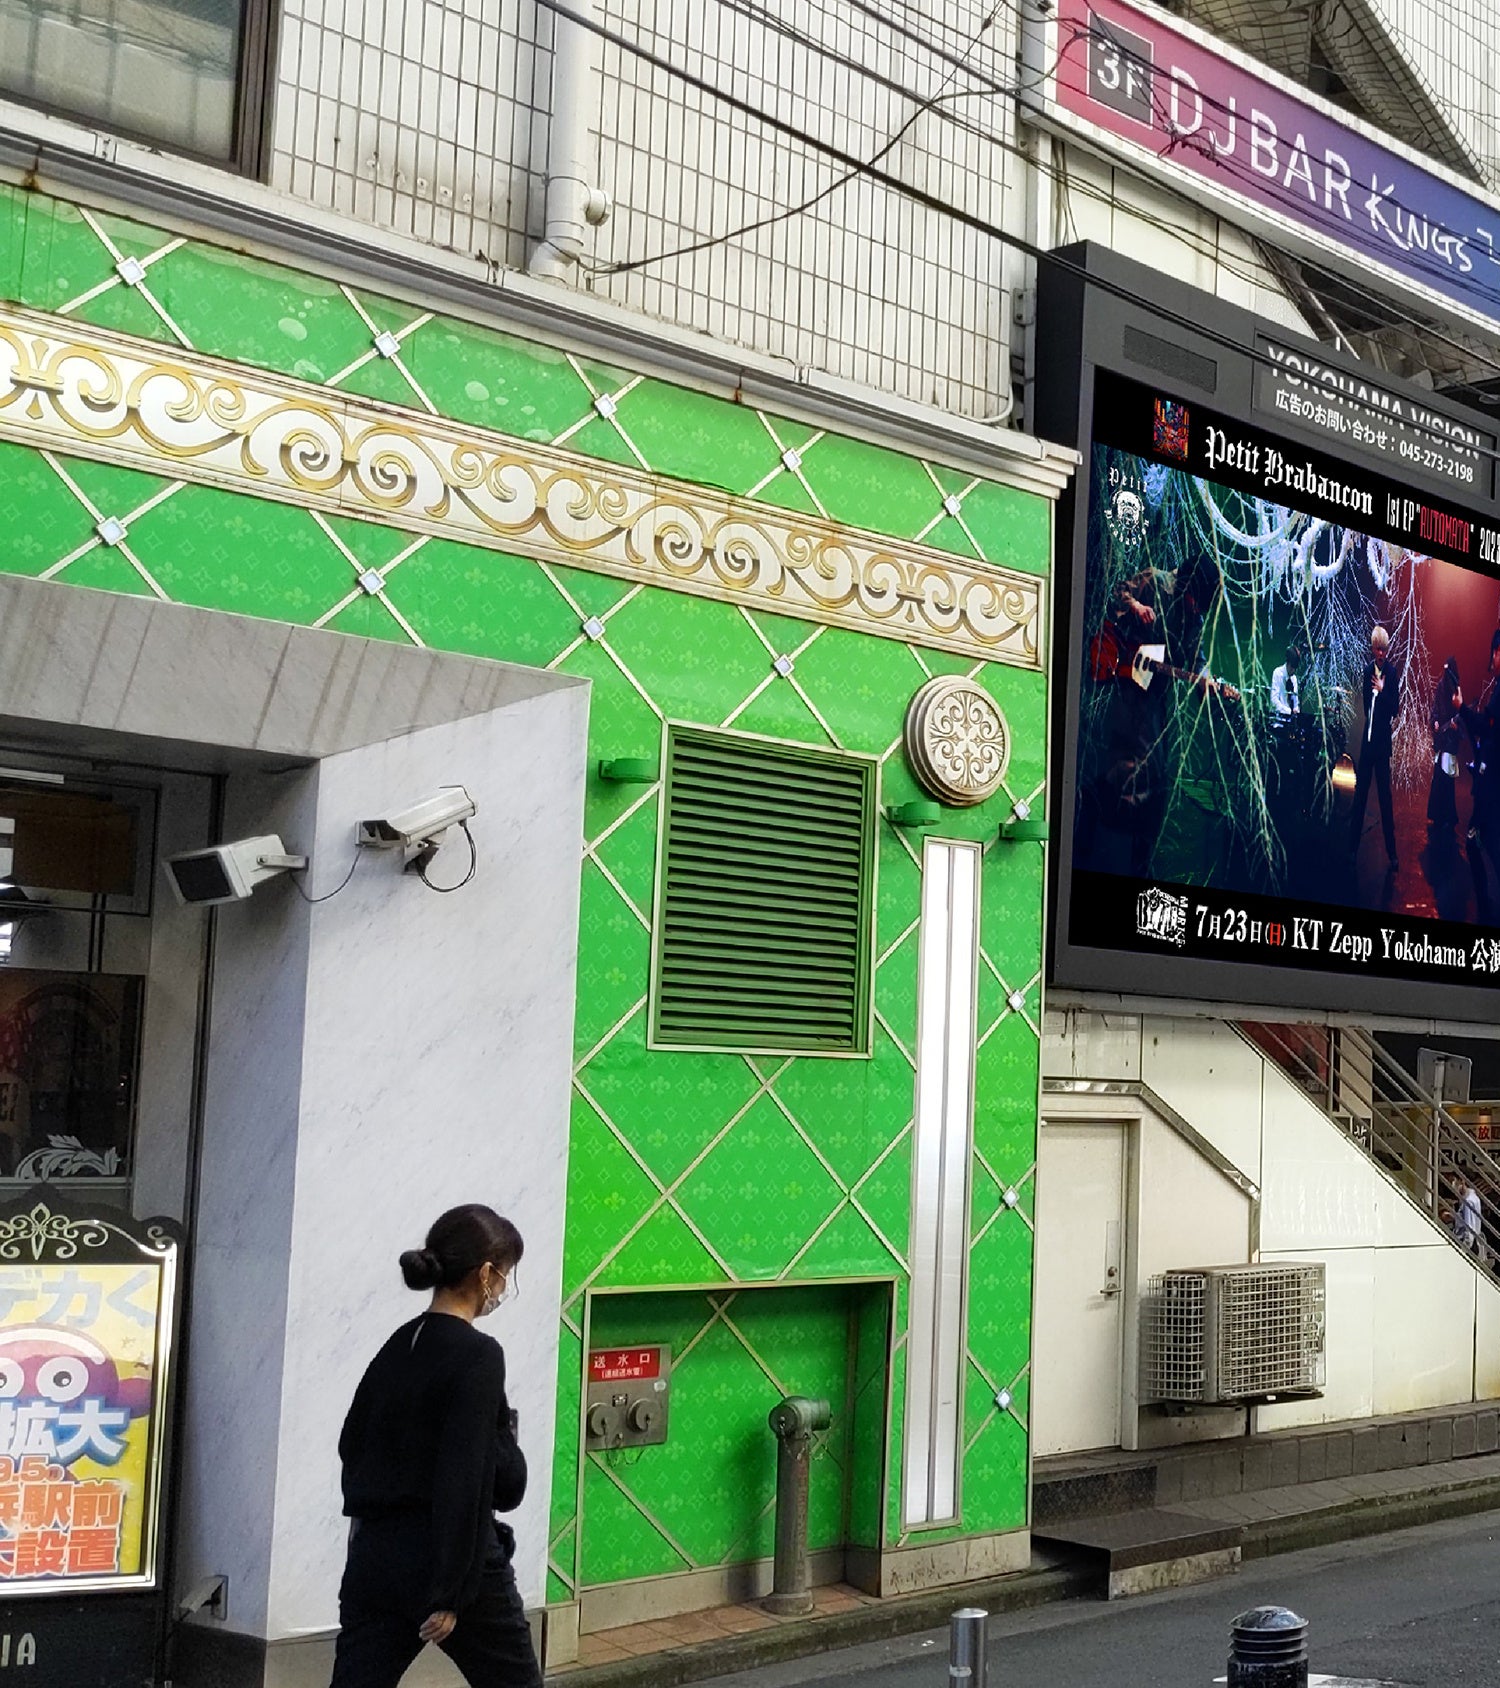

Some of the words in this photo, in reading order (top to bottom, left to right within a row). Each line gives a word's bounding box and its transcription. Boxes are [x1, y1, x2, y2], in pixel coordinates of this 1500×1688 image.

[1096, 40, 1146, 99] 3F
[1250, 108, 1352, 221] BAR
[1365, 174, 1473, 273] KINGS
[1268, 345, 1405, 430] YOKOHAMA
[1411, 407, 1481, 460] VISION
[1205, 426, 1260, 475] Petit
[1265, 447, 1373, 516] Brabancon
[1399, 440, 1474, 483] 045-273-2198
[1291, 917, 1323, 952] KT
[1329, 921, 1373, 962] Zepp
[1380, 928, 1467, 968] Yokohama
[594, 1352, 651, 1369] 送水口
[0, 1400, 127, 1458] 拡大
